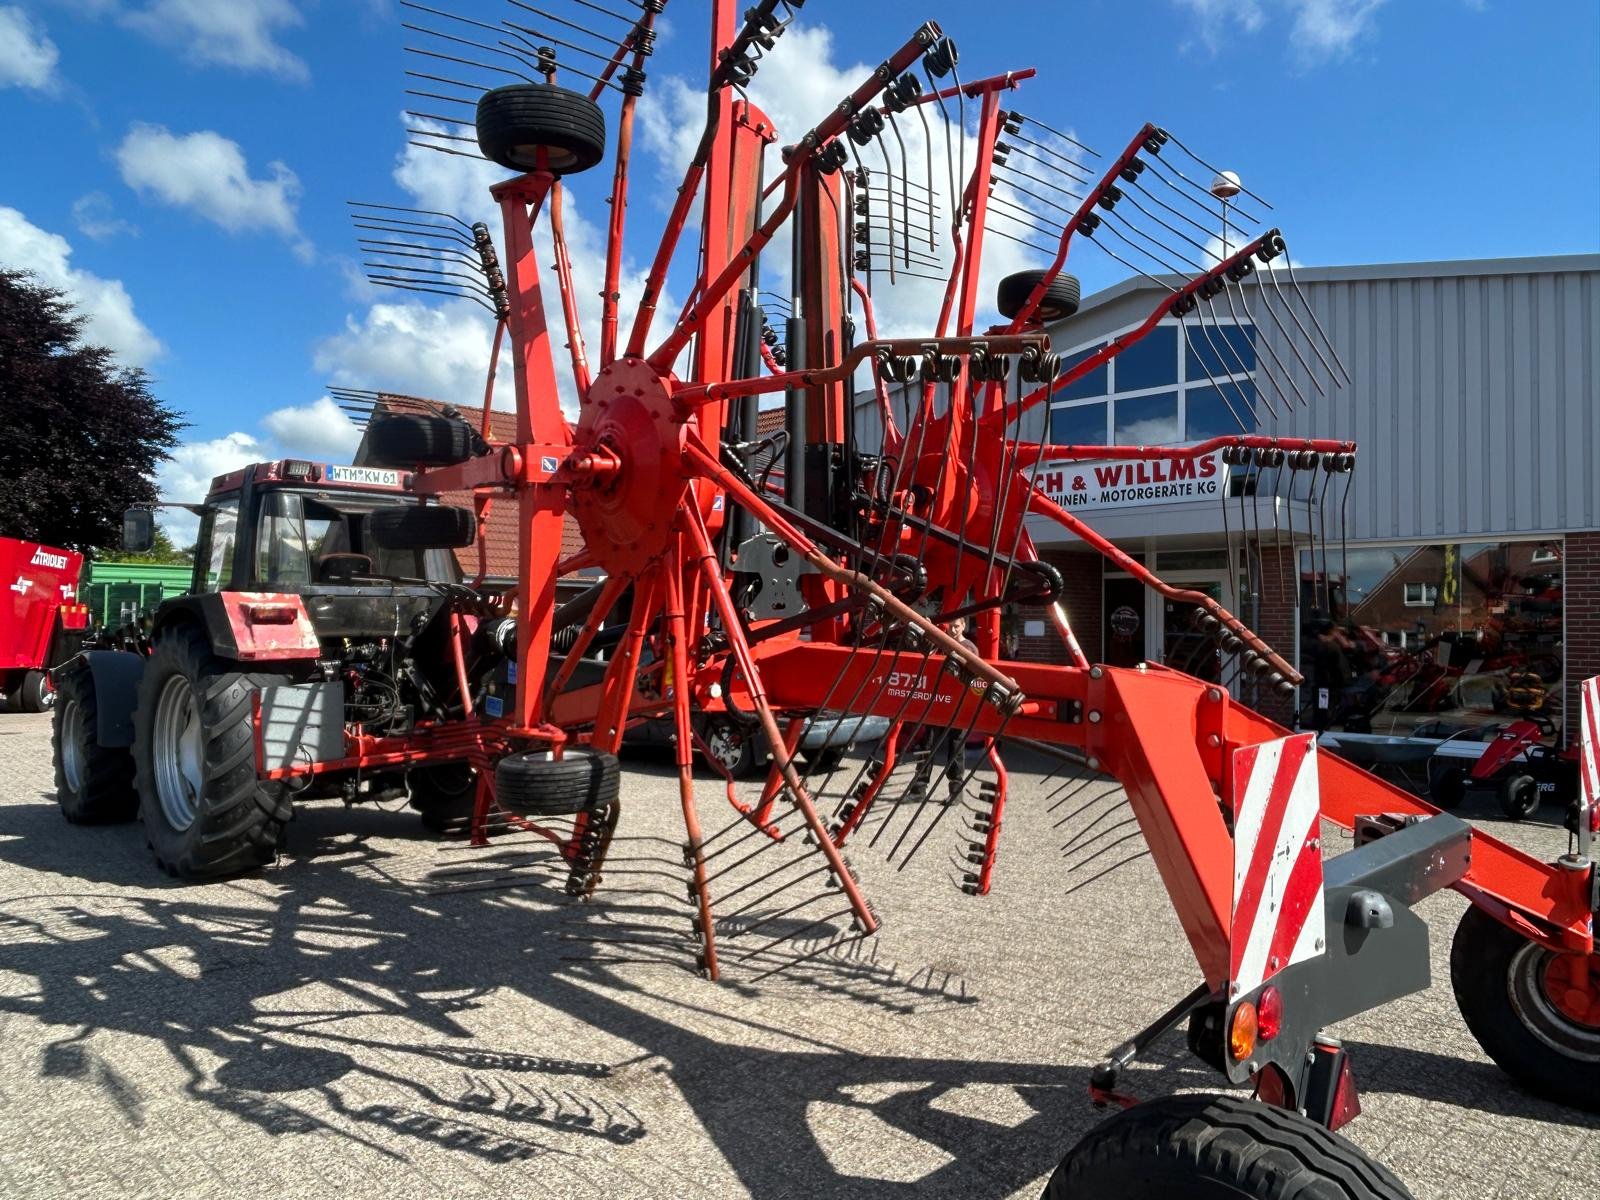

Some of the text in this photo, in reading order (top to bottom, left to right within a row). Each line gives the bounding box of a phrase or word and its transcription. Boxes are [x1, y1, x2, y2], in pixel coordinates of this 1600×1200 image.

[333, 468, 397, 484] WTM KW 61
[1072, 475, 1087, 490] &
[1094, 455, 1217, 488] WILLMS
[1101, 482, 1192, 503] MOTORGERÄTE
[1197, 480, 1217, 495] KG
[887, 688, 952, 703] MASTERDIVE
